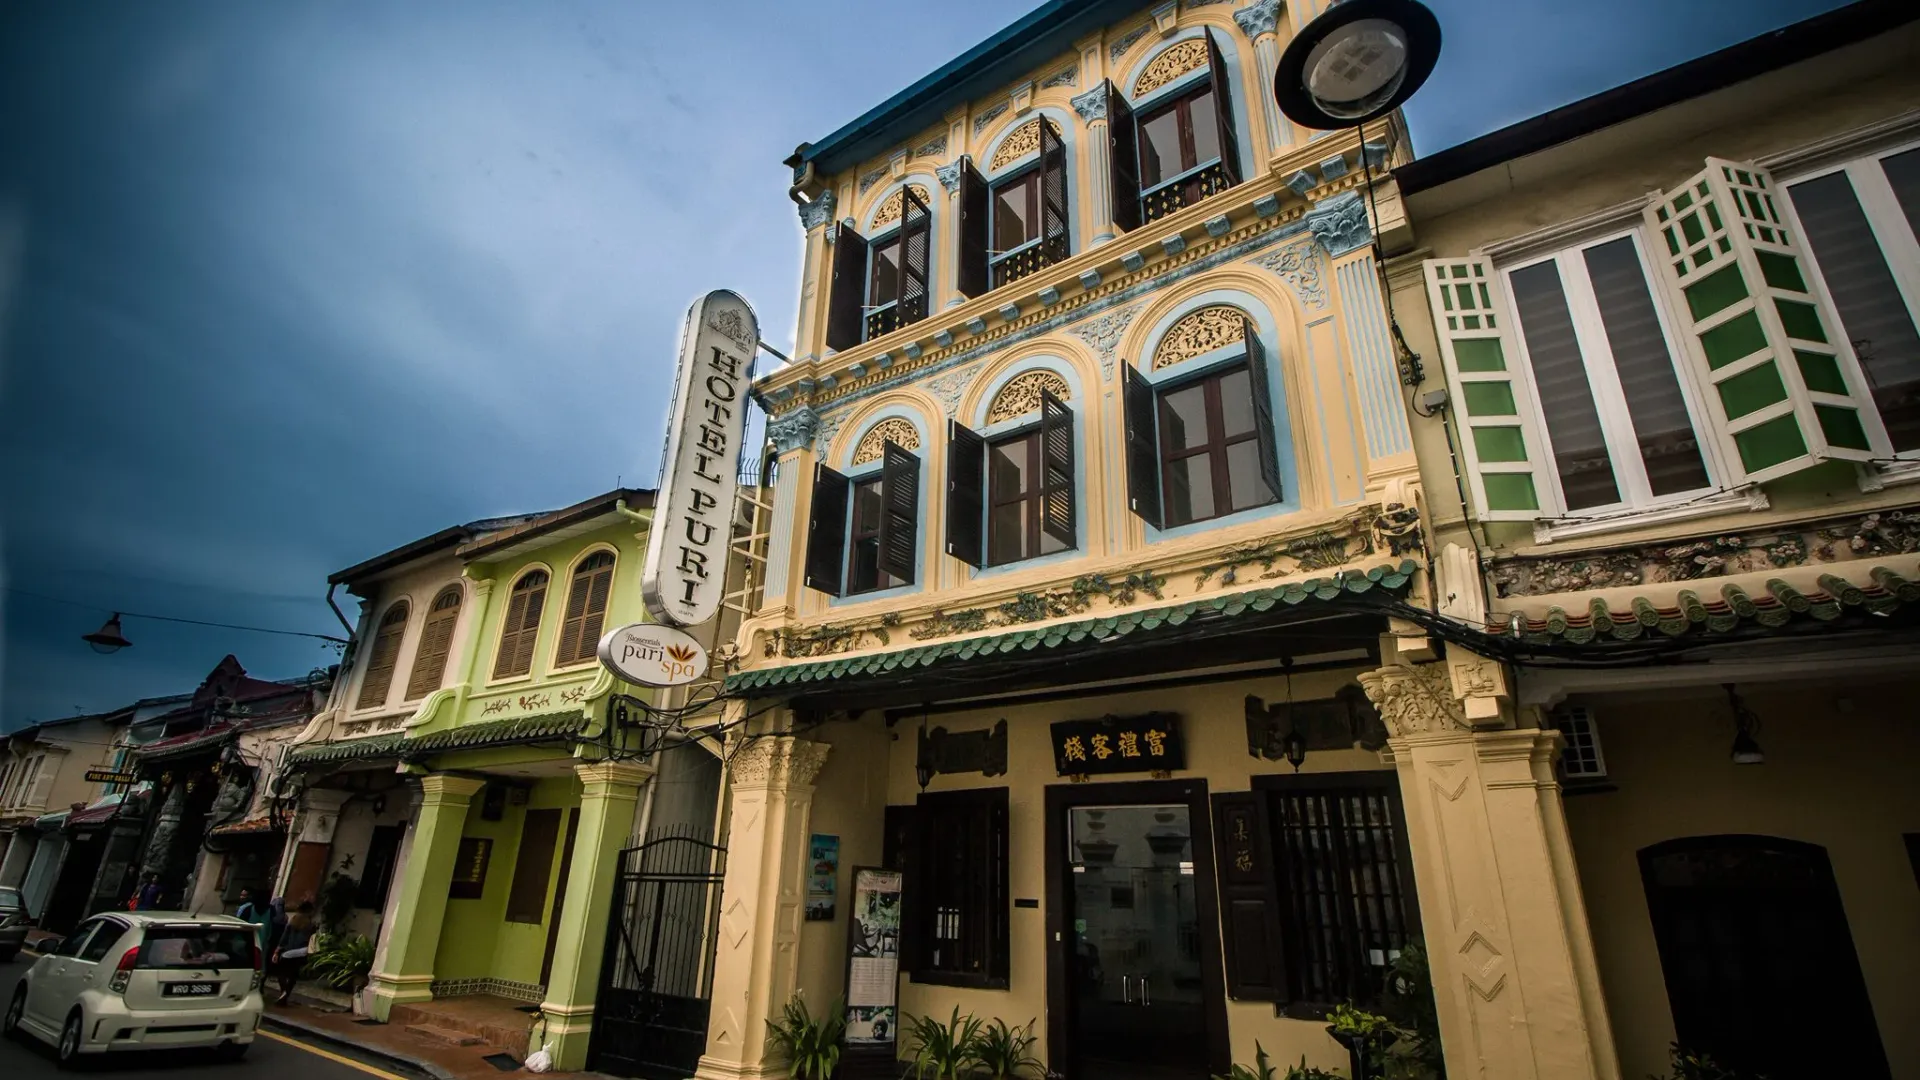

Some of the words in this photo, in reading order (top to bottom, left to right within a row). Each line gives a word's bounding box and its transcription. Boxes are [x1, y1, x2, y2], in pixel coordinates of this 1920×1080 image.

[694, 346, 743, 484] HOTEL
[676, 487, 718, 607] PURI
[621, 644, 664, 663] puri
[661, 660, 695, 682] spa
